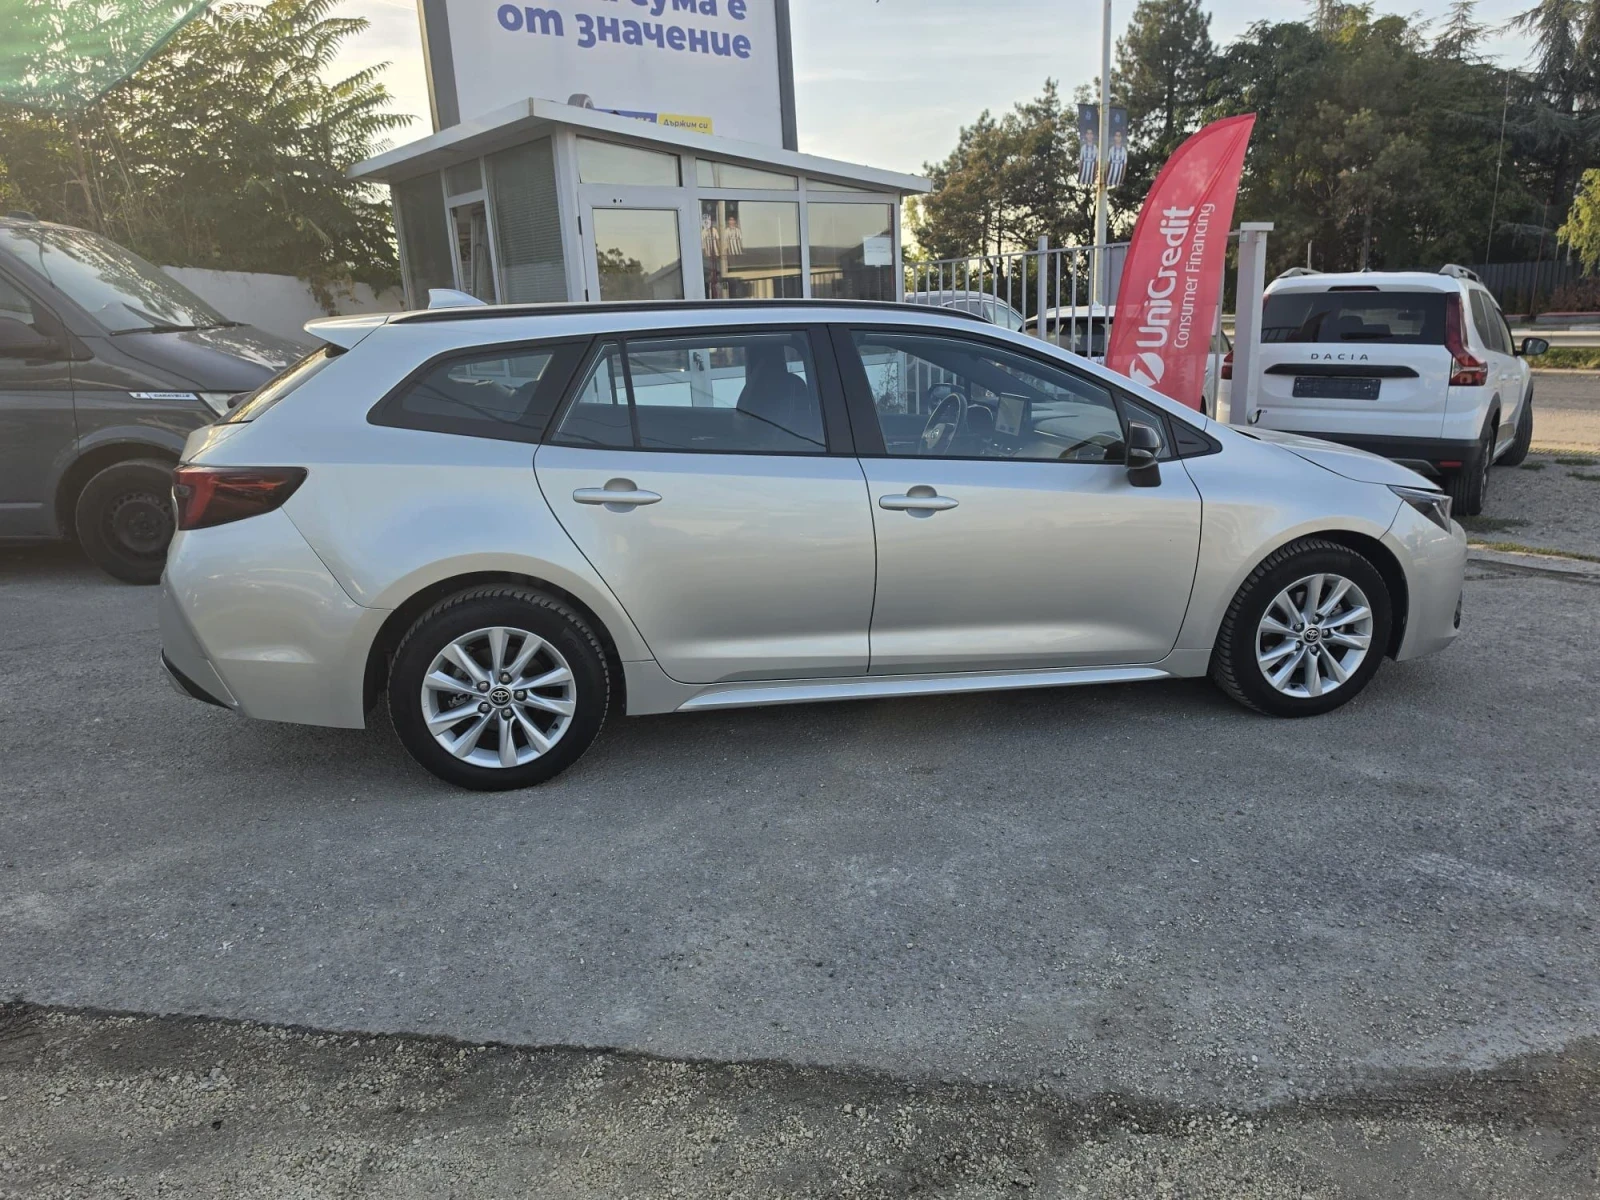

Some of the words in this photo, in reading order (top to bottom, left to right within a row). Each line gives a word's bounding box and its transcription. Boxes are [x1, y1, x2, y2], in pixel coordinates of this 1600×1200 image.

[498, 3, 564, 37] от
[574, 13, 751, 59] значение
[663, 118, 697, 129] Държим
[1185, 203, 1215, 273] Financing
[1136, 206, 1195, 348] UniCredit
[1174, 275, 1199, 349] Consumer
[1311, 353, 1369, 361] DACIA
